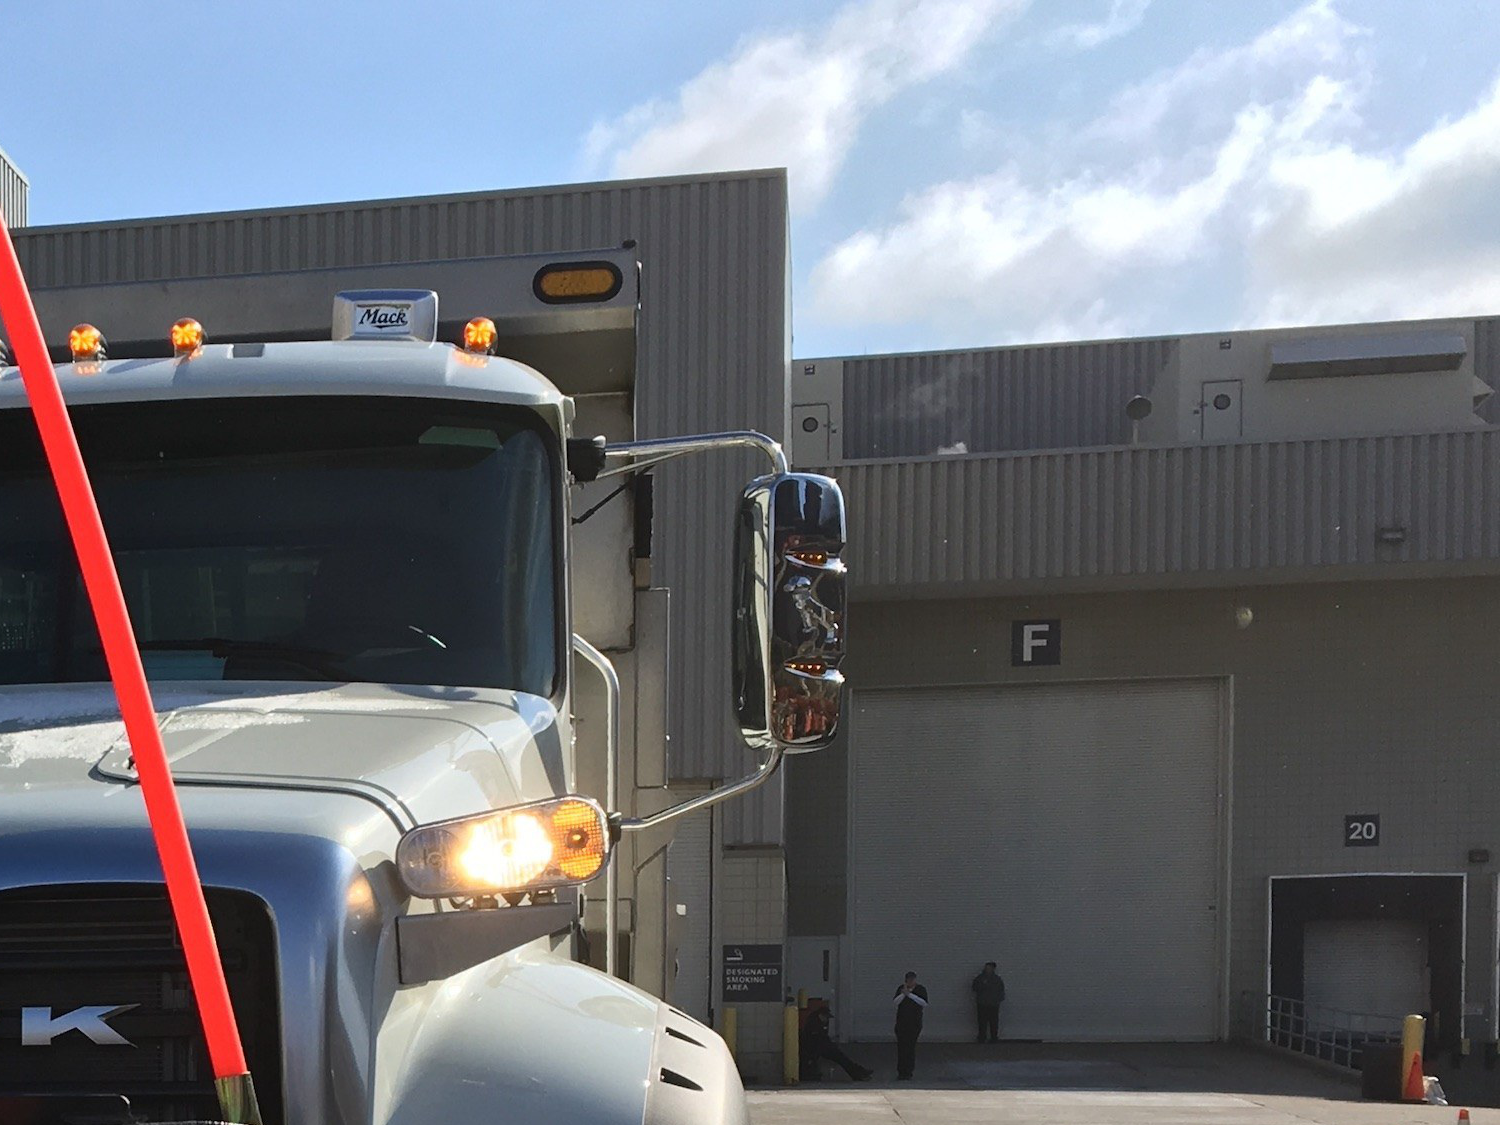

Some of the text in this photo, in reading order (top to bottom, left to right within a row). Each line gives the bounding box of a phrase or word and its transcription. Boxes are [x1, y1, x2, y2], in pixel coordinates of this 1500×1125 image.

[359, 308, 408, 328] Mack
[1022, 624, 1049, 662] F
[1349, 822, 1377, 841] 20
